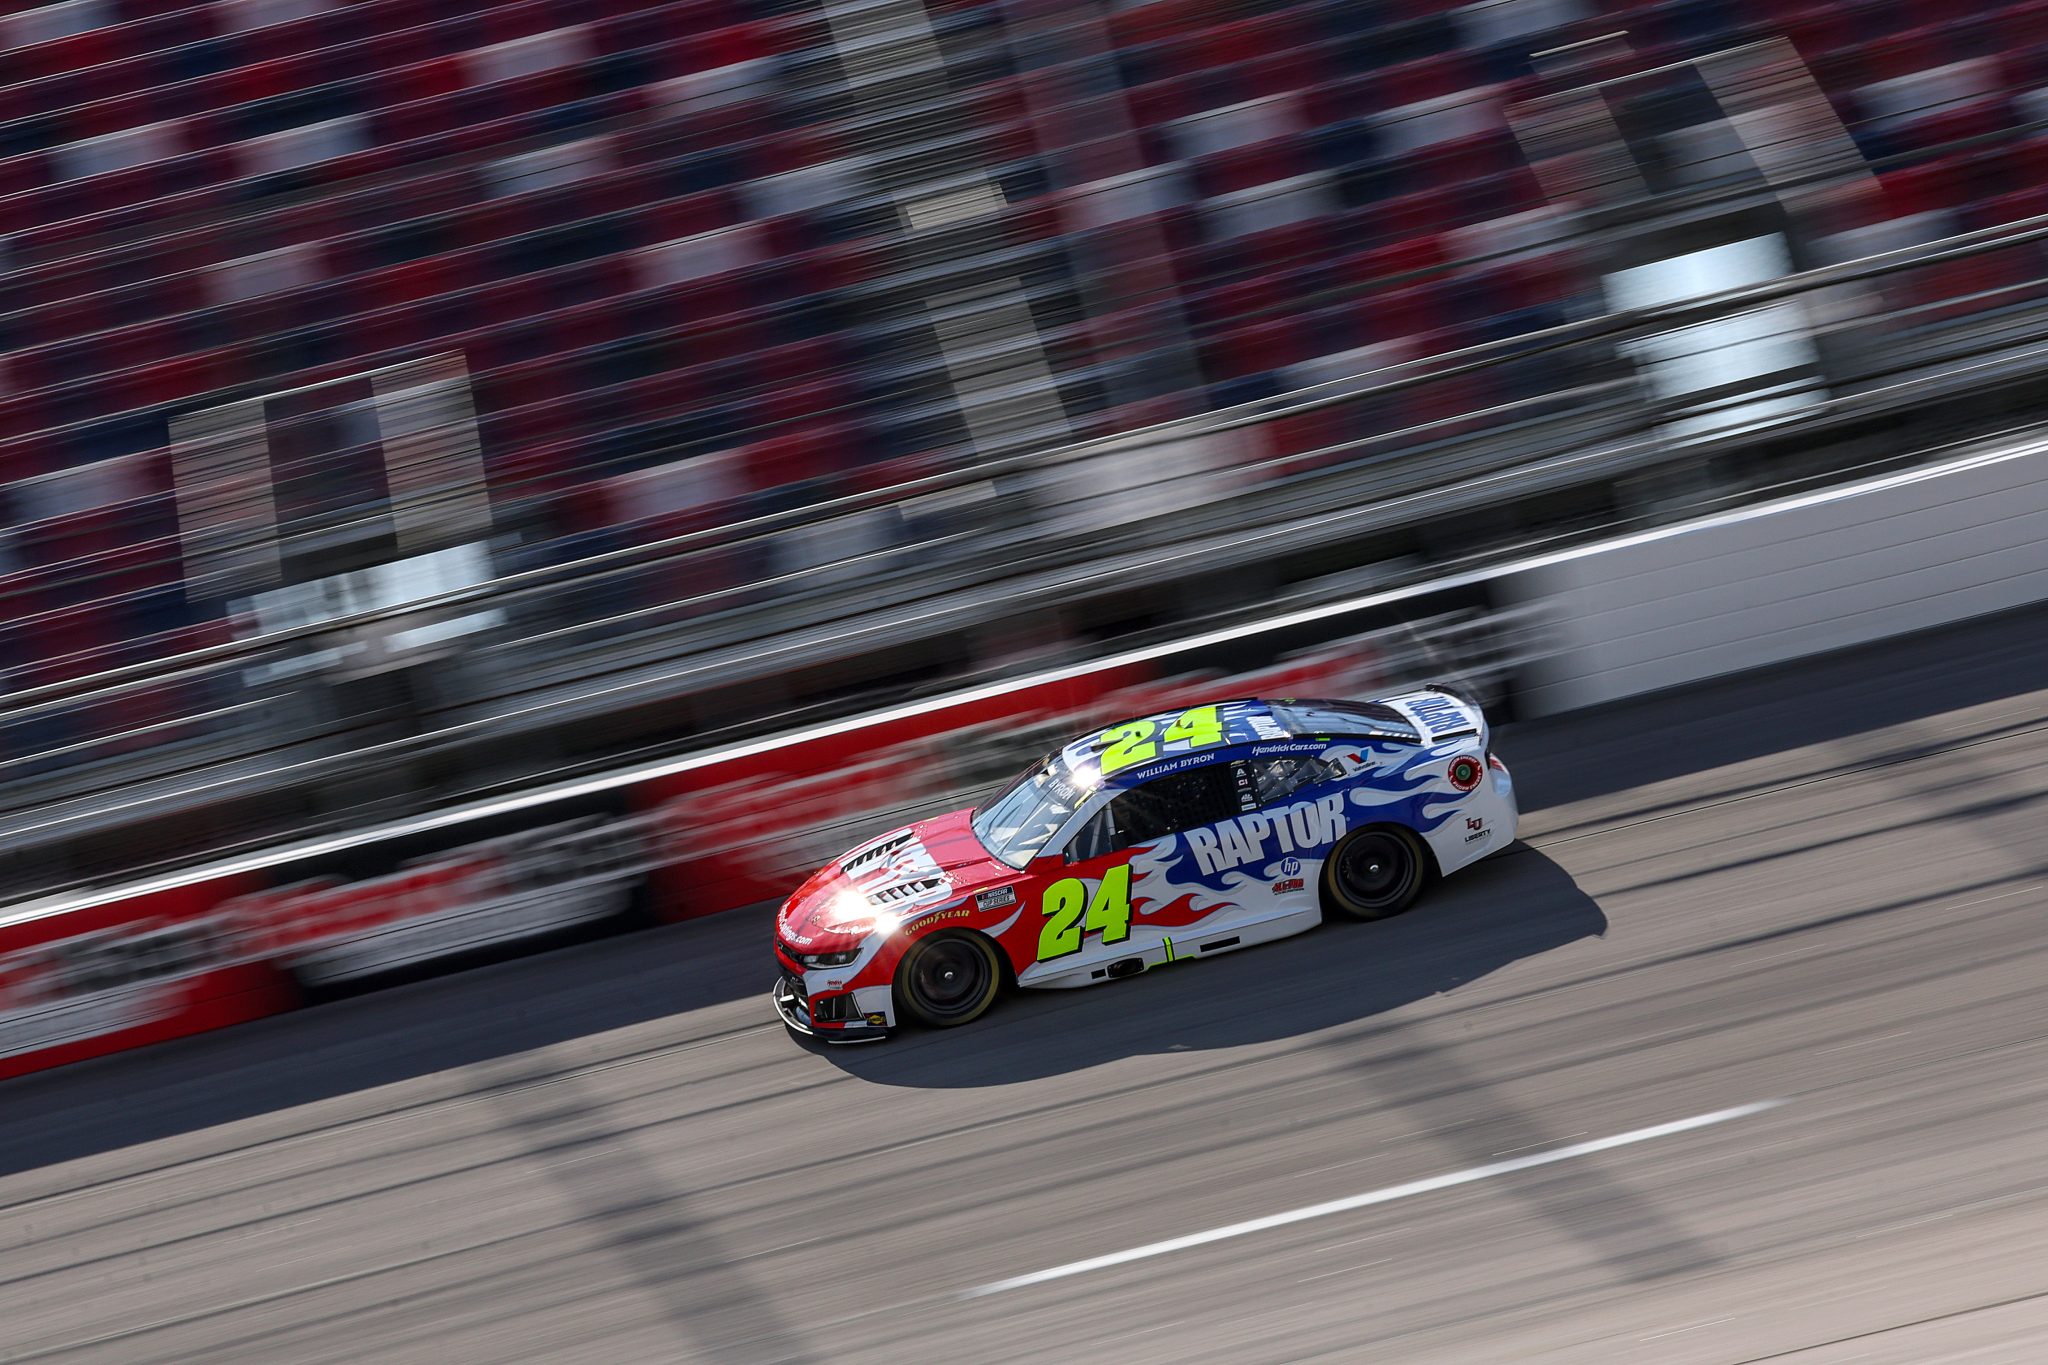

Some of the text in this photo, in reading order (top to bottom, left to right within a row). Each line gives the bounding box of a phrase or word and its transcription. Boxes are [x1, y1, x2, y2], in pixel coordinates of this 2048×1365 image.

[1405, 696, 1470, 733] RAPTOR
[1100, 706, 1222, 775] 24
[1137, 753, 1215, 779] WILLIAM BYRON
[1048, 779, 1076, 800] BYRON
[1184, 793, 1347, 875] RAPTOR
[1465, 828, 1491, 842] LIBERTY
[1284, 858, 1299, 876] hp
[987, 888, 1008, 898] NASCAR
[905, 909, 970, 936] GOODYEAR
[1036, 863, 1133, 962] 24
